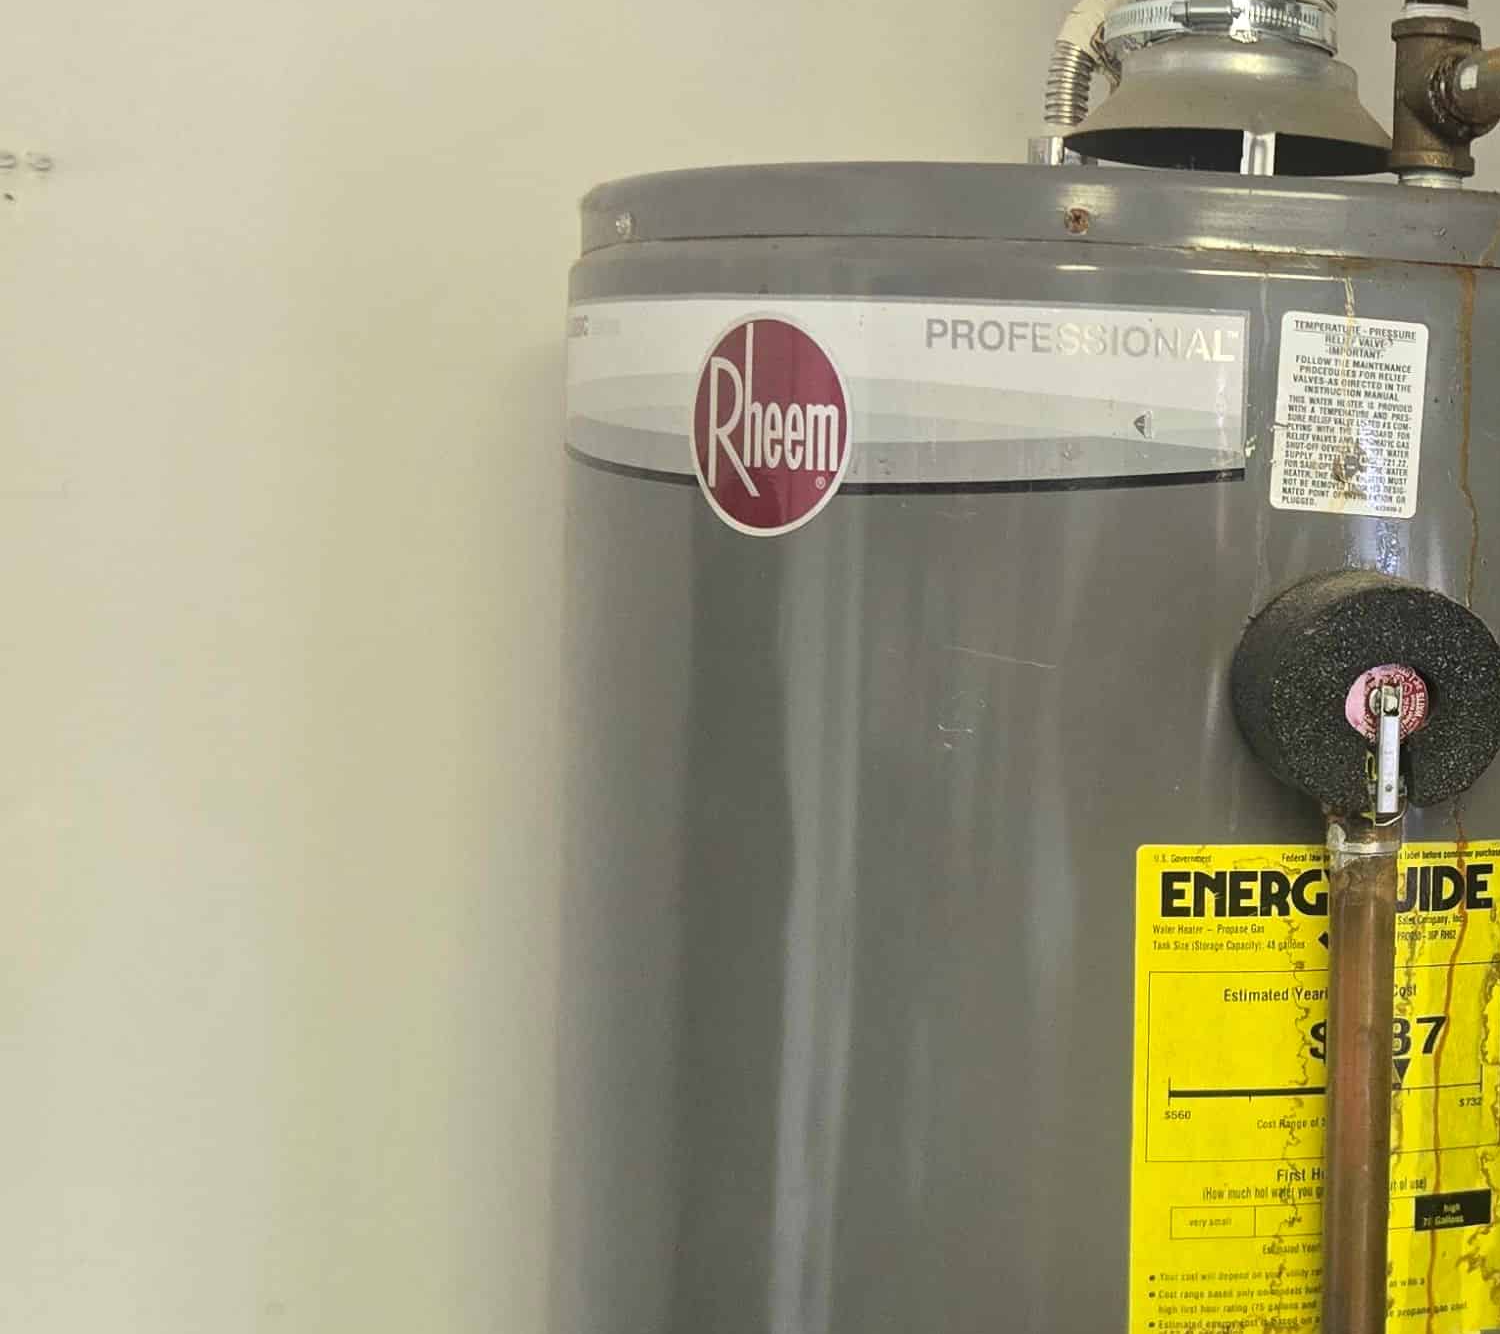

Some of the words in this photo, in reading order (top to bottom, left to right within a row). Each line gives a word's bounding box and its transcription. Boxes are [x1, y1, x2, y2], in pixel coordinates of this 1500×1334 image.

[925, 318, 1235, 362] PROFESSIONAL
[1369, 327, 1416, 341] PRESSURE
[1296, 355, 1331, 366] FOLLOW
[1353, 359, 1412, 373] MAINTENANCE
[1360, 370, 1376, 380] FOR
[1379, 372, 1407, 383] RELIEF
[1385, 382, 1394, 390] IN
[1397, 383, 1412, 393] THE
[708, 322, 838, 497] Rheem
[1250, 923, 1265, 934] Gas
[1153, 940, 1170, 950] Tank
[1174, 940, 1189, 950] Size
[1223, 987, 1289, 1003] Estimated
[1294, 987, 1328, 1002] Yearl
[1256, 1118, 1276, 1130] Cost
[1276, 1168, 1306, 1183] First
